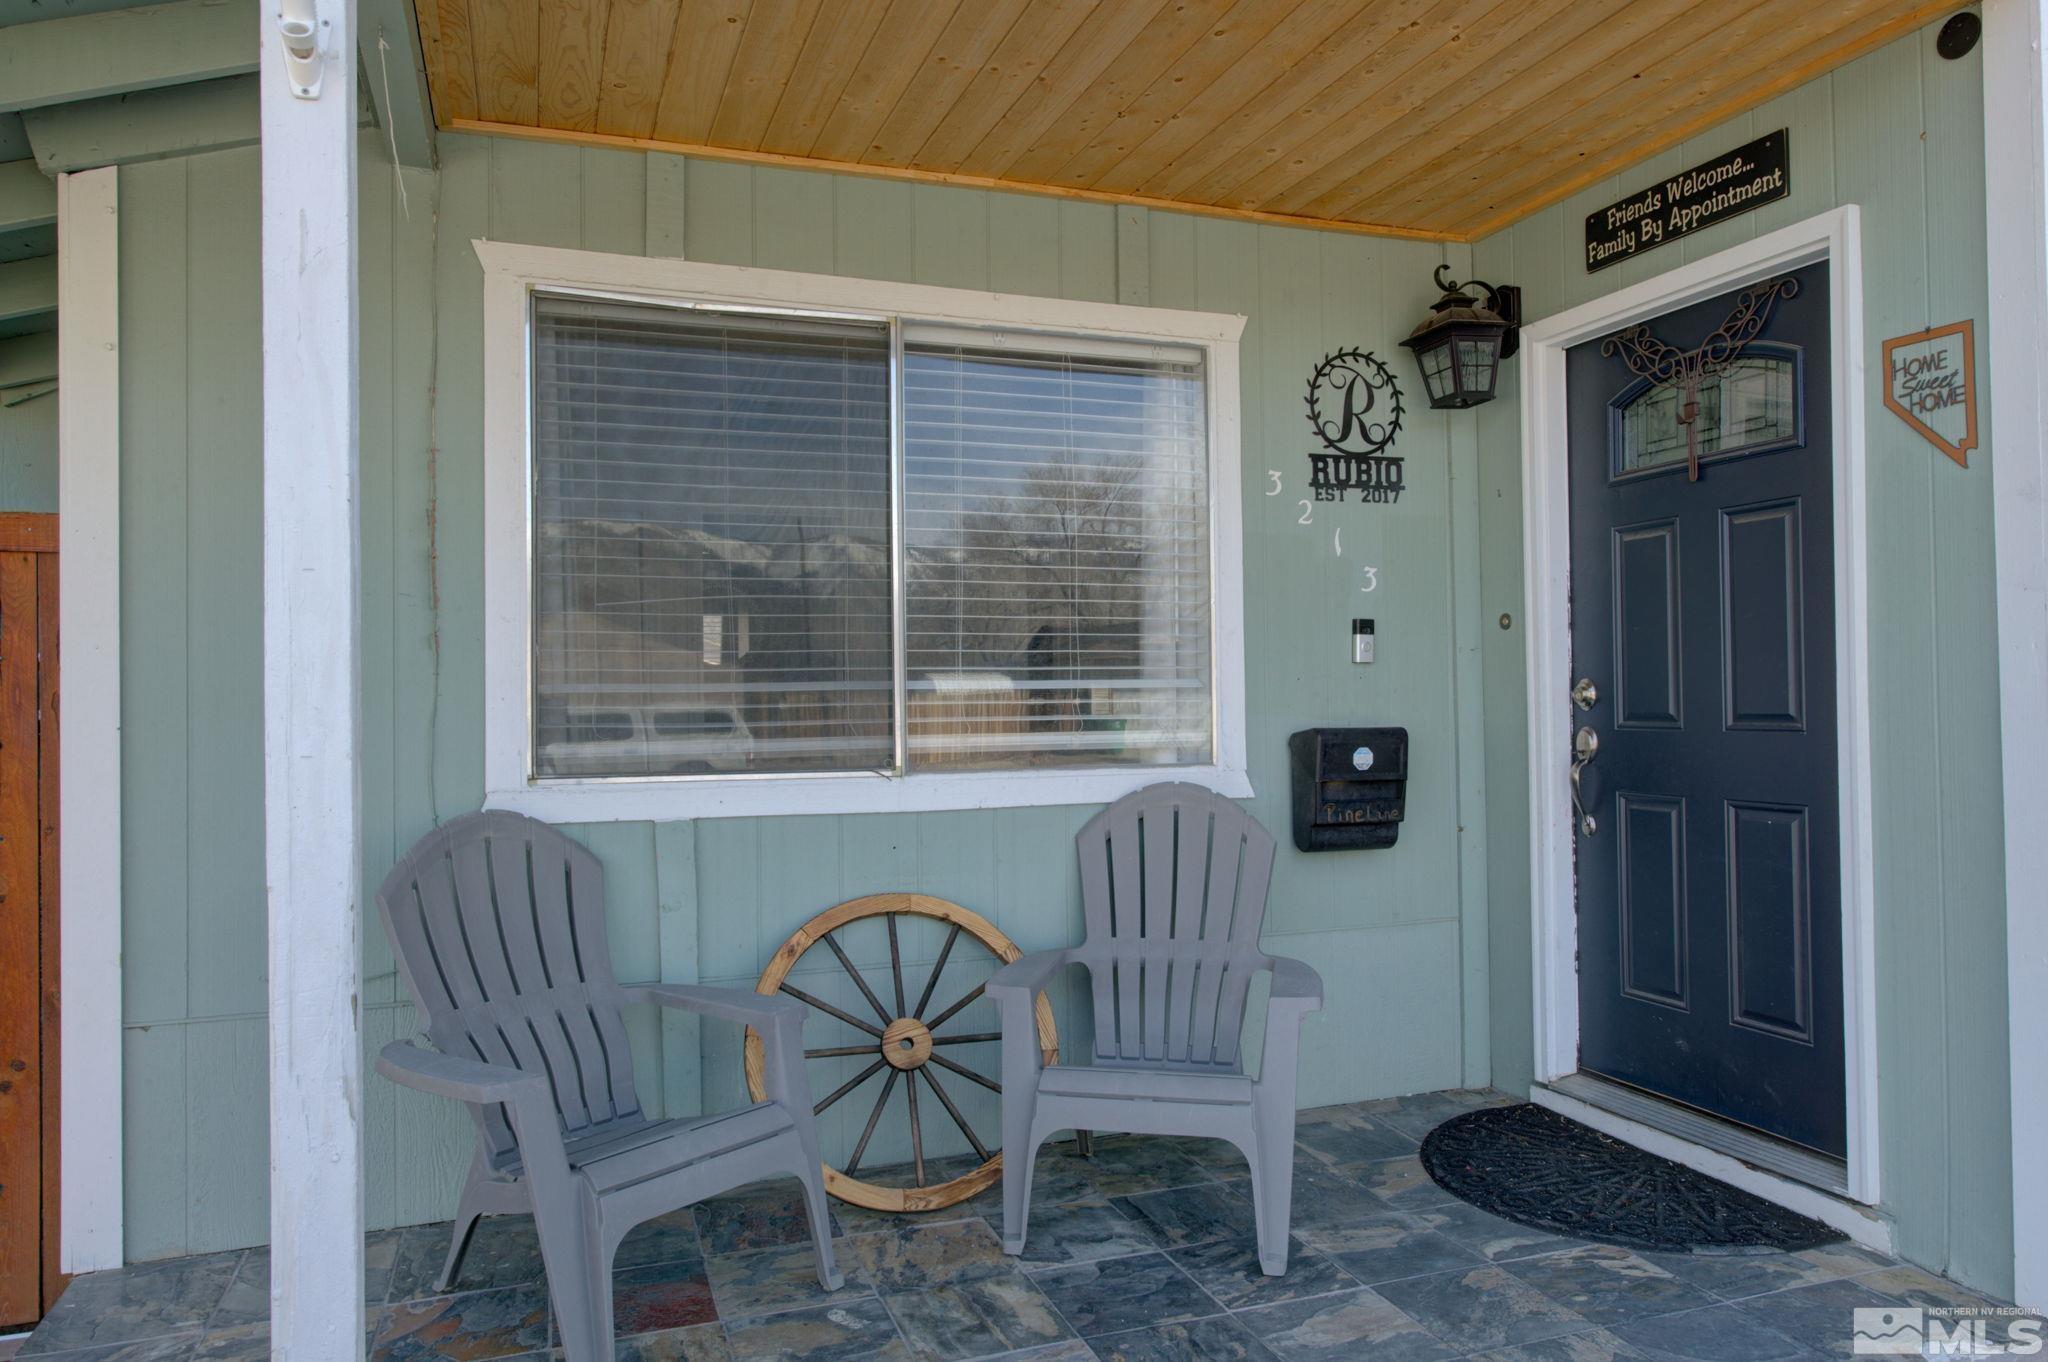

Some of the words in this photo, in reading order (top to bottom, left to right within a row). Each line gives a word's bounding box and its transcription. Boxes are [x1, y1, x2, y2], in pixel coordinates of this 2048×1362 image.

[1588, 229, 1636, 264] Family
[1641, 218, 1663, 242] By
[1668, 167, 1784, 232] Appointment
[1607, 191, 1661, 230] Friends
[1893, 349, 1949, 381] HOME
[1898, 368, 1960, 399] Sweet
[1909, 384, 1967, 415] HOME
[1308, 453, 1405, 490] RUBIO
[1314, 487, 1348, 502] EST
[1361, 489, 1400, 504] 2017
